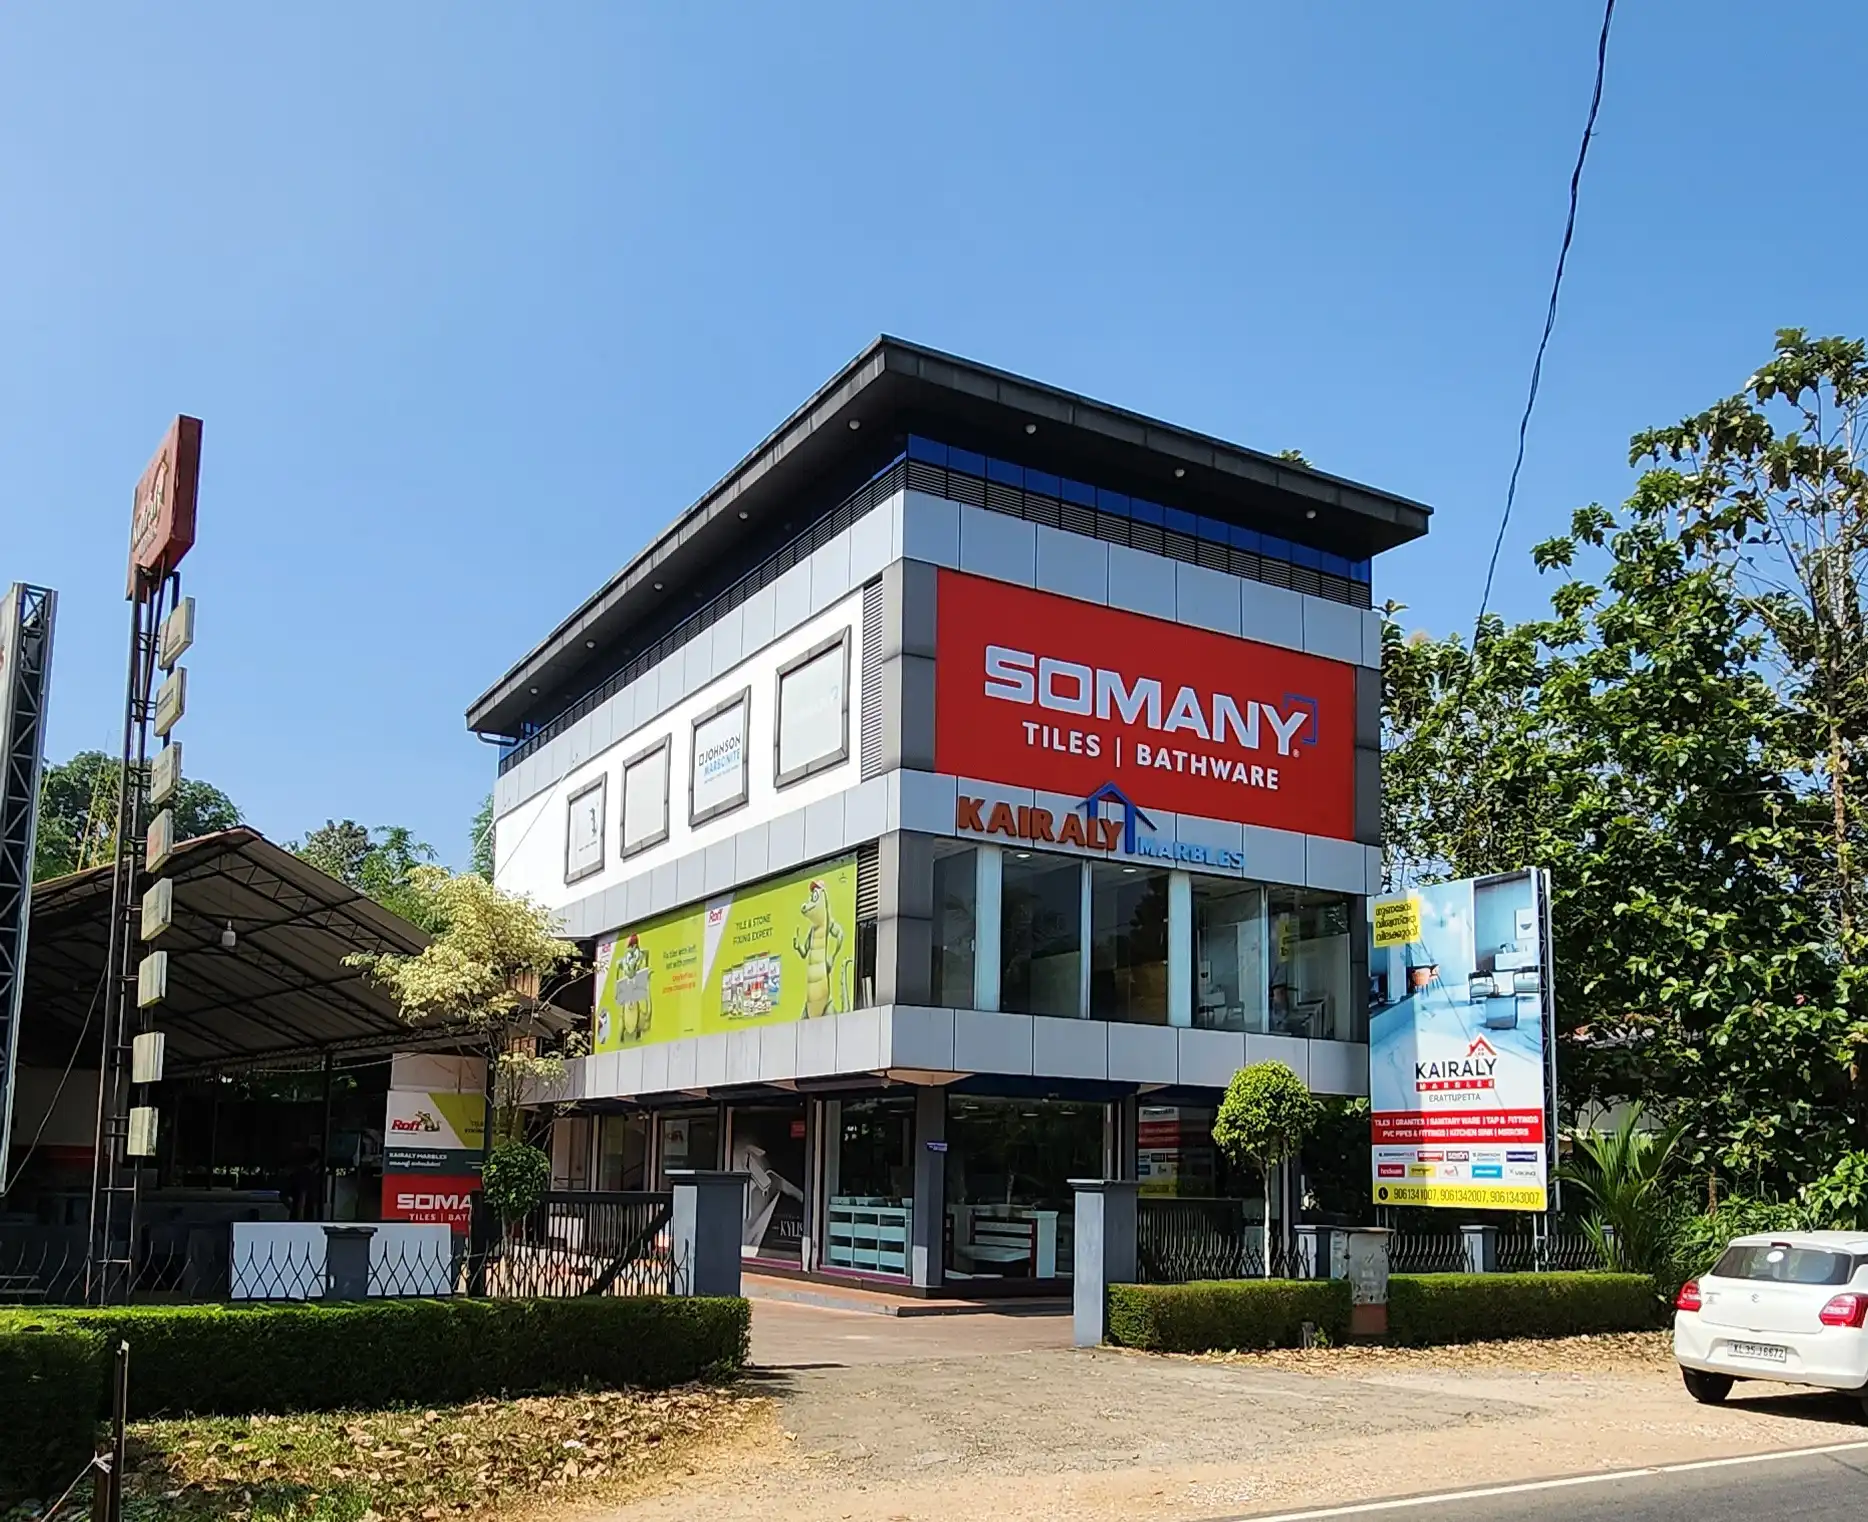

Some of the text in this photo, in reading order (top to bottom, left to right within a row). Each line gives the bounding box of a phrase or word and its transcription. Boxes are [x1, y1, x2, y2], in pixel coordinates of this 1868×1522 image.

[985, 644, 1308, 756] SOMANY
[704, 733, 741, 764] JOHNSON
[1022, 721, 1280, 791] TILES BATHWARE
[957, 796, 1125, 851] KAIRALY
[1138, 837, 1245, 869] MARBLES
[735, 919, 747, 931] TILE
[752, 913, 771, 927] STONE
[751, 927, 773, 942] EXPERT
[1415, 1058, 1497, 1080] KAIRALY
[1428, 1093, 1481, 1103] ERATTUPETTA
[391, 1119, 421, 1131] Roff
[1382, 1130, 1395, 1138] PVC
[1396, 1130, 1412, 1138] PIPES
[1490, 1190, 1540, 1204] 9061343007
[409, 1213, 436, 1221] TILES
